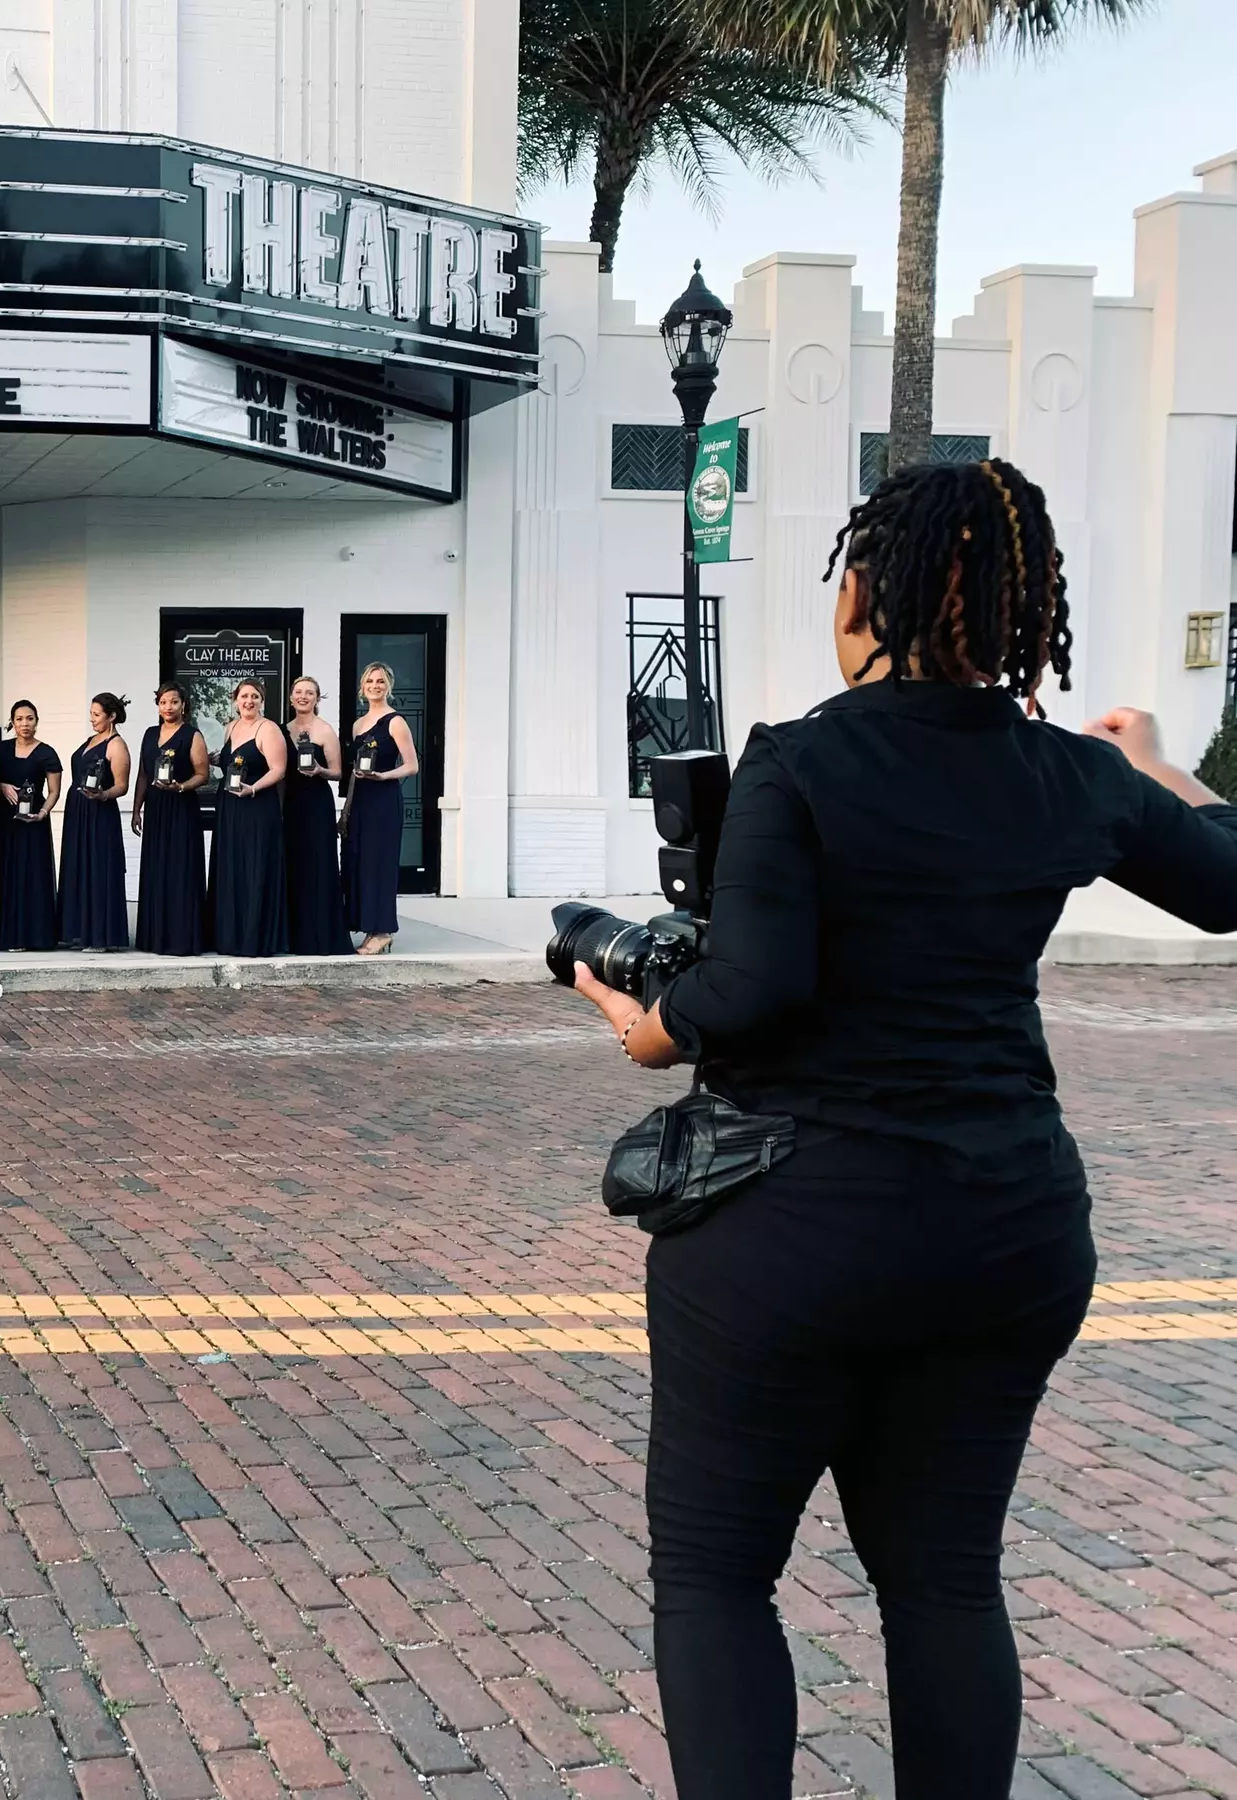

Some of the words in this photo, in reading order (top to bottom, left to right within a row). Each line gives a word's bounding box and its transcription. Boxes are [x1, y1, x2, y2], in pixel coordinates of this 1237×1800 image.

[191, 162, 519, 338] THEATRE
[236, 364, 288, 410] NOW
[247, 405, 288, 448] THE
[295, 419, 386, 470] WALTERS
[702, 439, 732, 454] Welcome
[185, 648, 215, 662] CLAY
[218, 648, 270, 662] THEATRE
[199, 669, 219, 677] NOW
[220, 669, 255, 677] SHOWING
